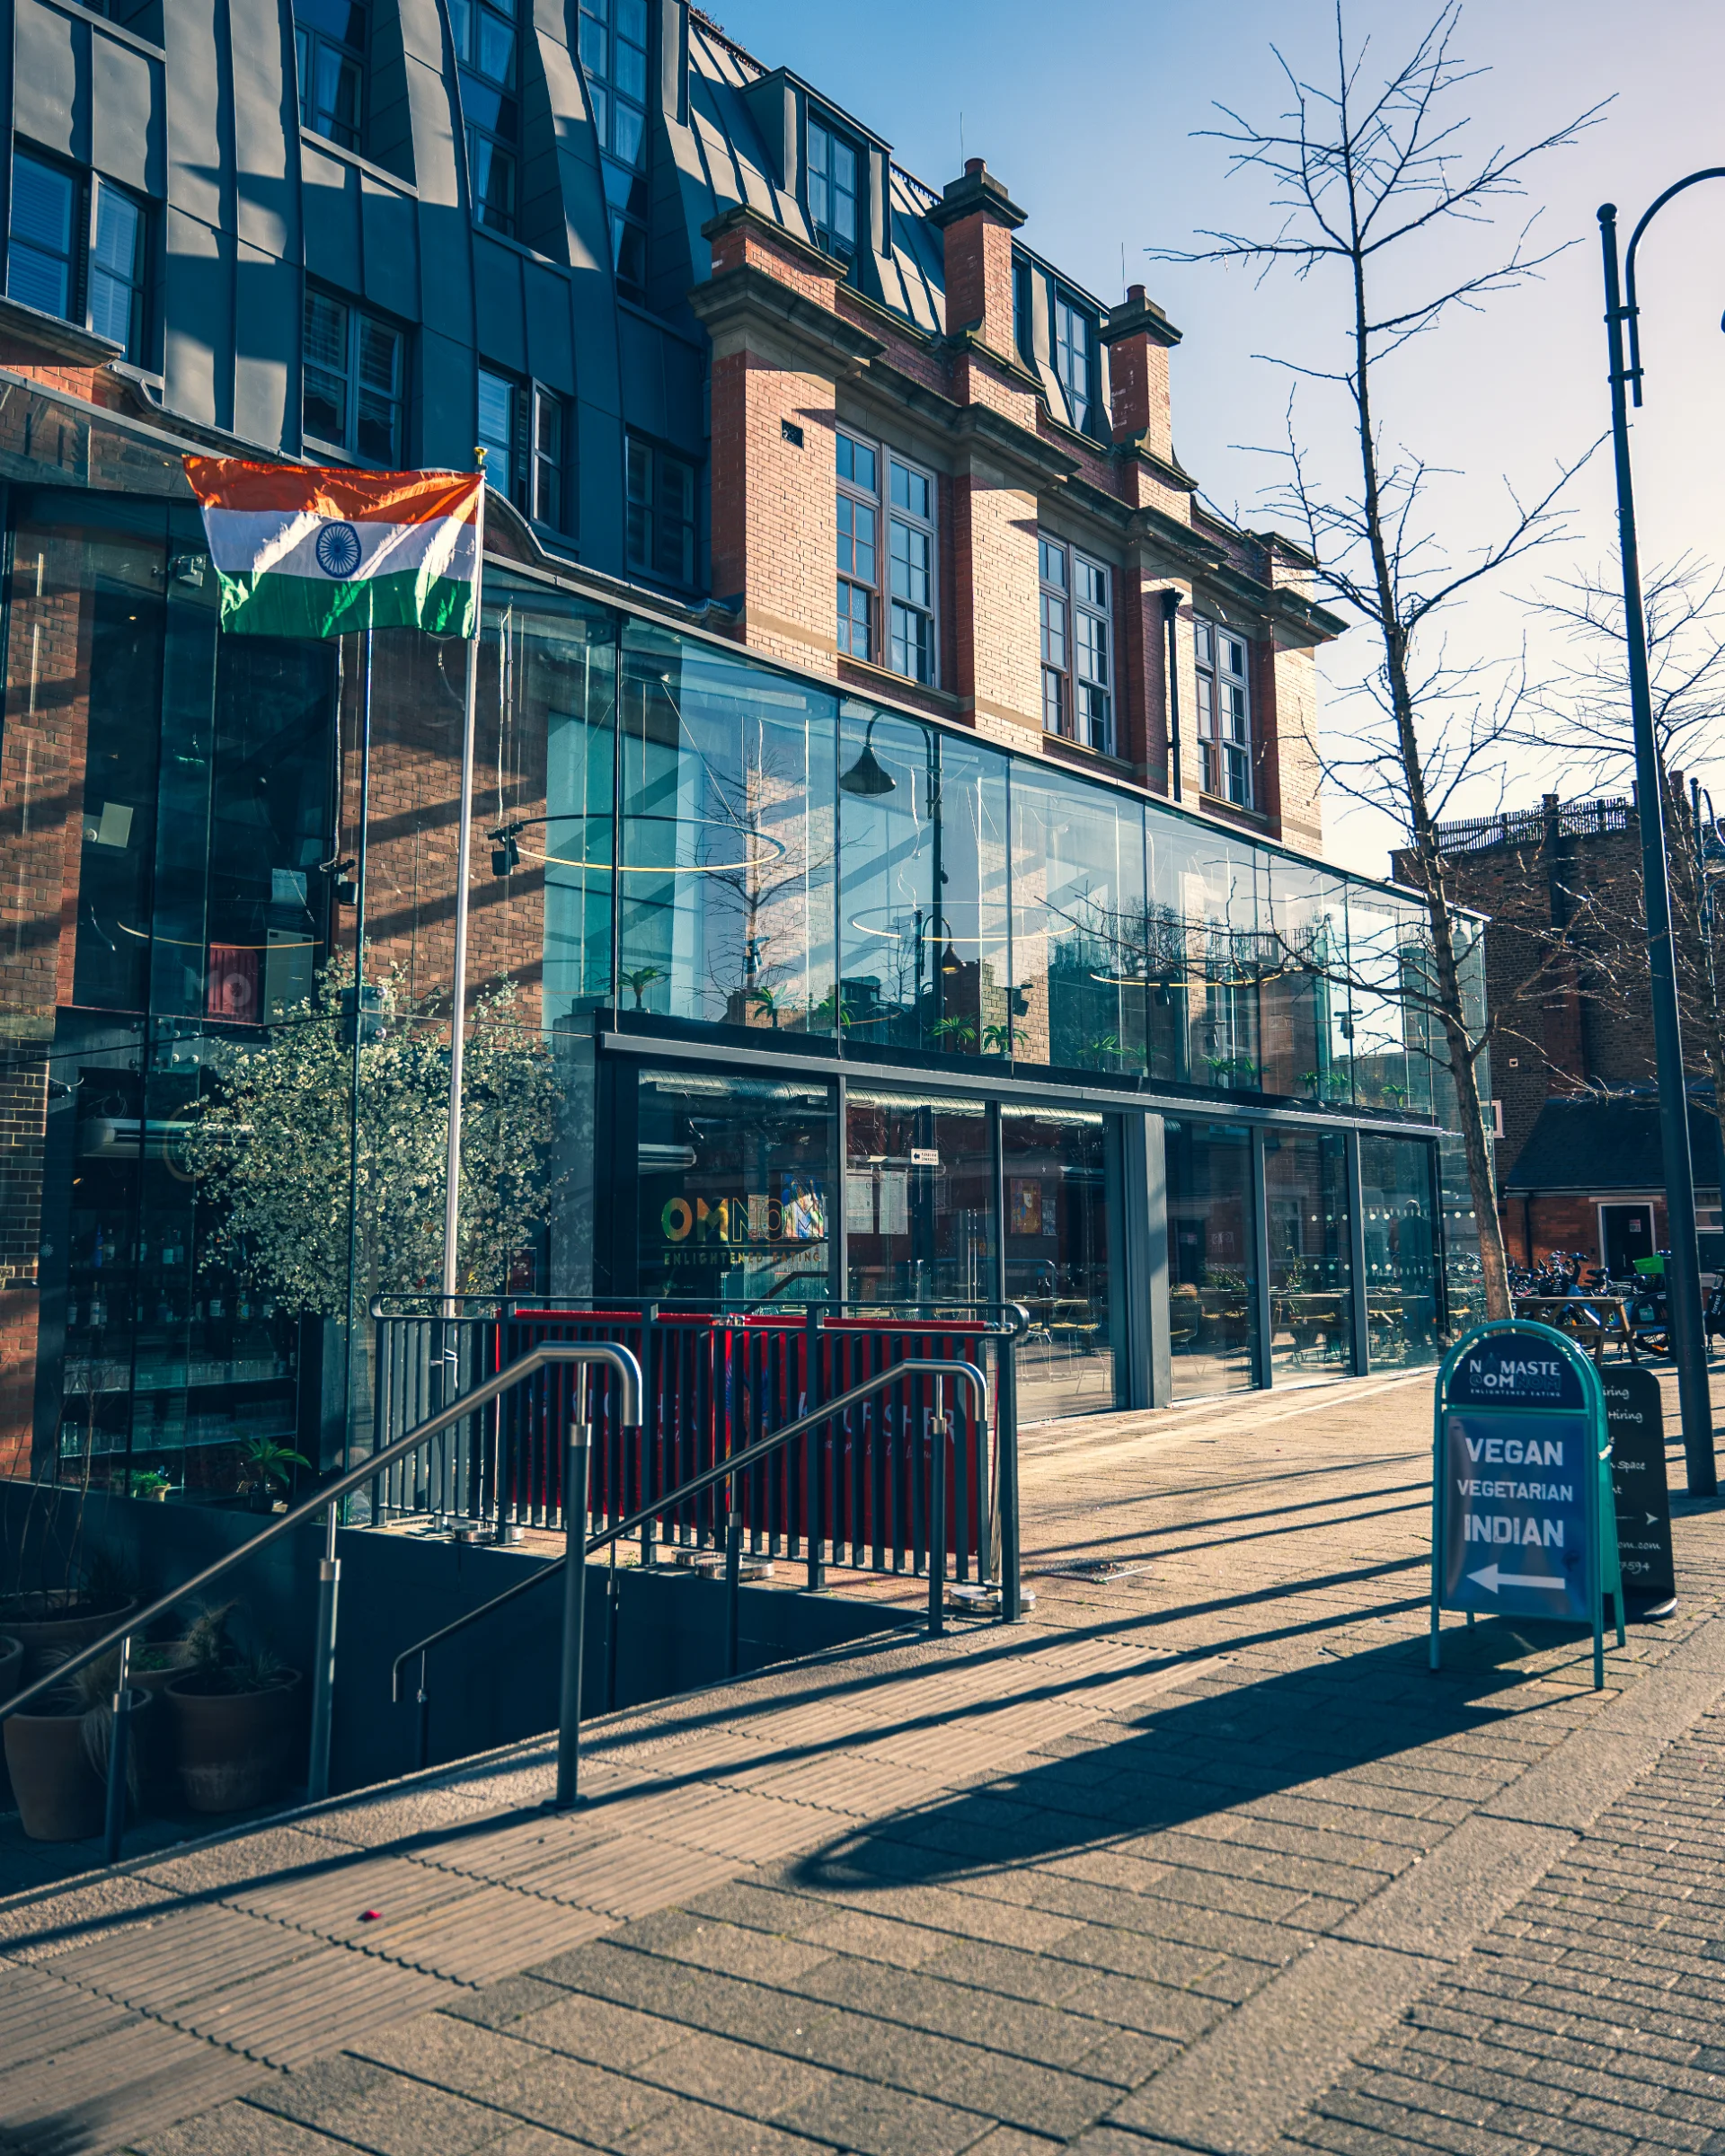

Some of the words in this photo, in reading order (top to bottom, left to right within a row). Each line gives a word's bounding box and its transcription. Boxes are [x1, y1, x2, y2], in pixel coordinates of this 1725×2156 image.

[664, 1251, 763, 1266] ENLIGHTENED
[772, 1251, 821, 1264] EATING
[1602, 1384, 1630, 1401] iring
[1607, 1409, 1643, 1424] Hiring
[1465, 1437, 1563, 1466] VEGAN
[1616, 1460, 1646, 1474] Space
[1457, 1479, 1573, 1502] VEGETARIAN
[1464, 1513, 1564, 1548] INDIAN
